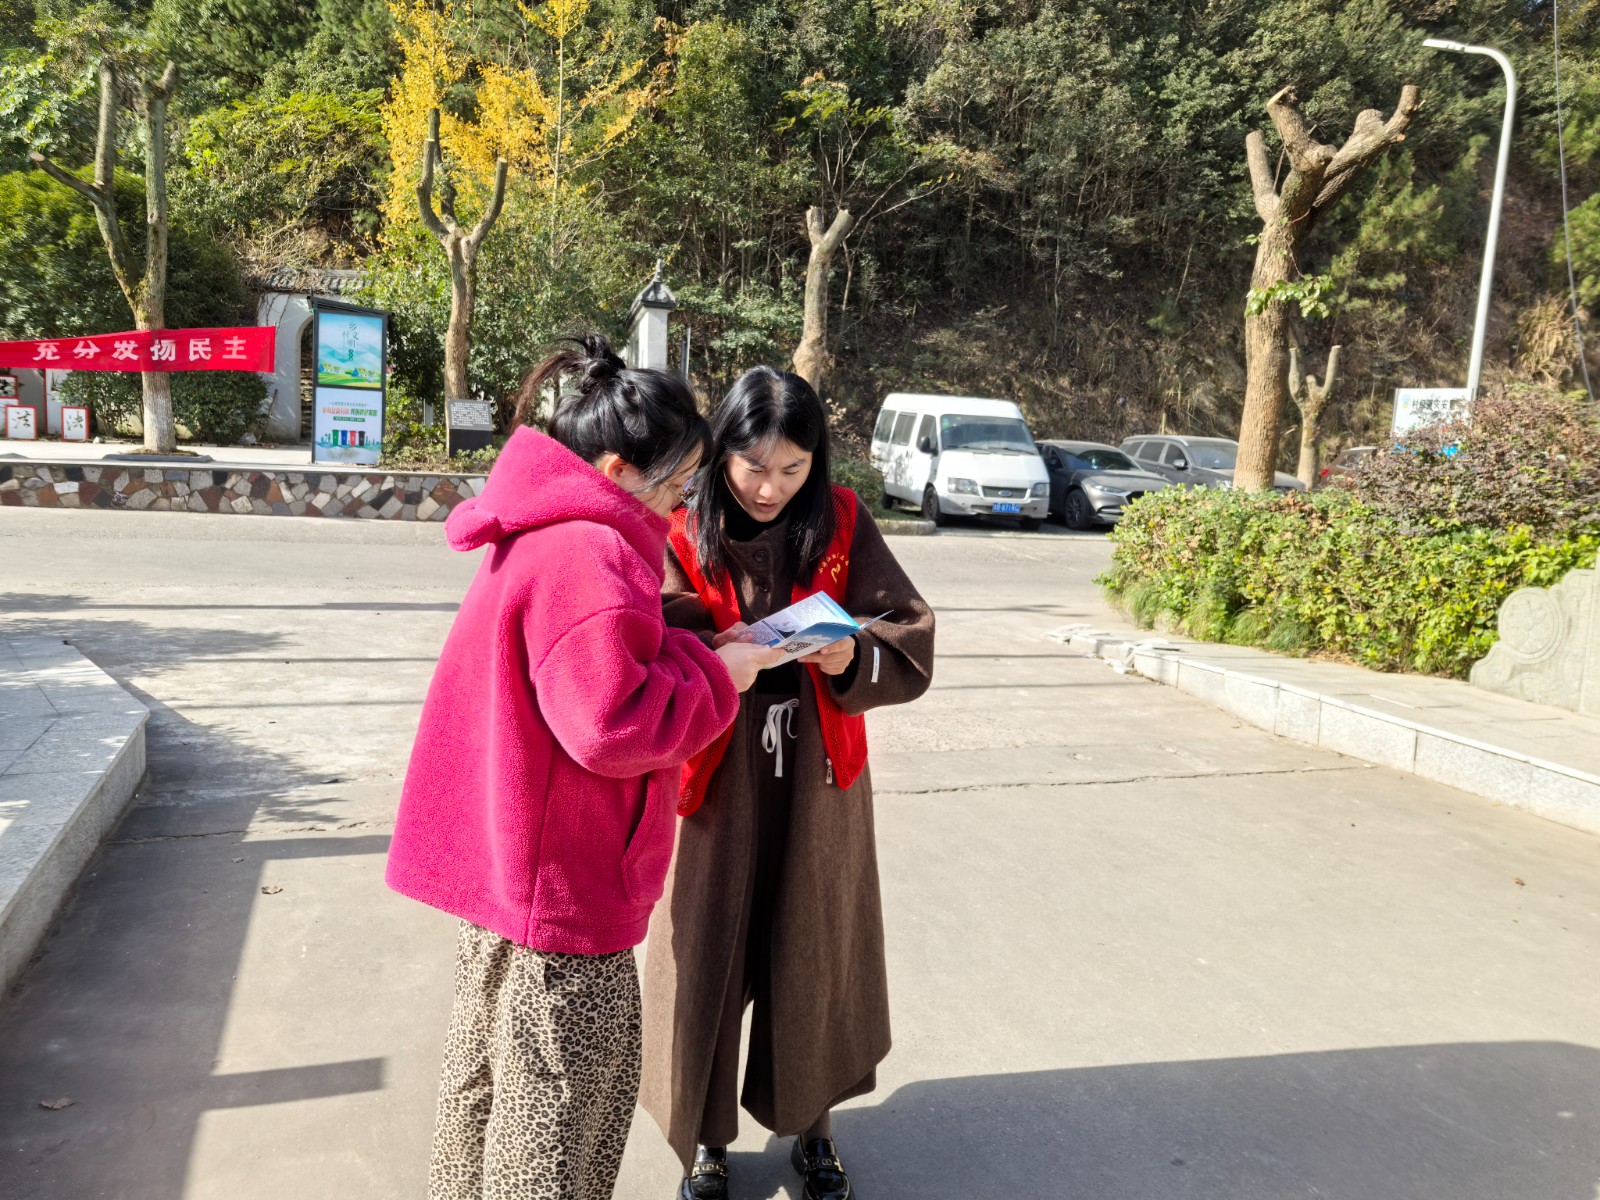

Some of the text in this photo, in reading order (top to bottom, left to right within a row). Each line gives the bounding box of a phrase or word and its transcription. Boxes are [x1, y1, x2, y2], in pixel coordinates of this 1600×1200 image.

[32, 335, 247, 361] 充分发扬民主
